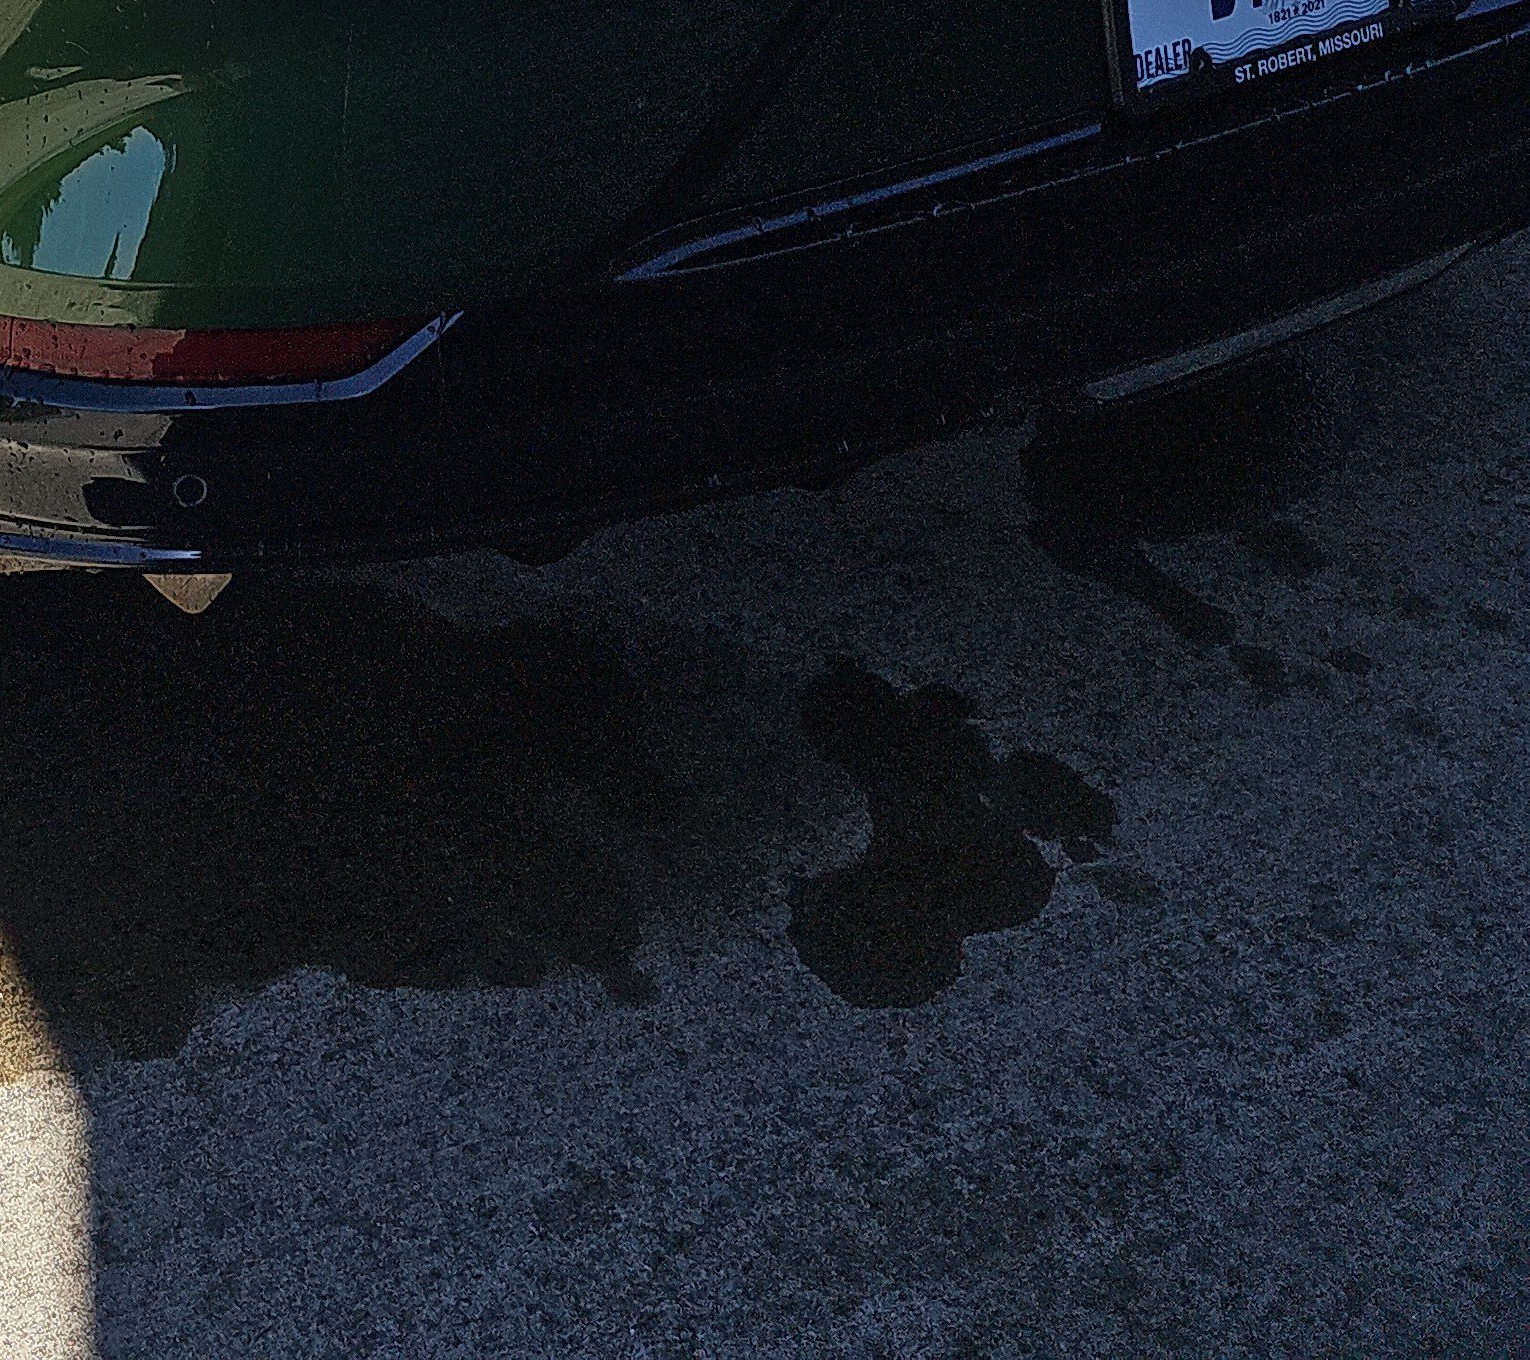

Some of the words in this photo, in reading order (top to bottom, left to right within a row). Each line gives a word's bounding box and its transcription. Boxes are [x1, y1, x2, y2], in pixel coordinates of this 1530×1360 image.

[1268, 6, 1292, 25] 1821
[1134, 38, 1192, 81] DEALER
[1234, 63, 1256, 84] ST.
[1258, 44, 1317, 78] ROBERT,
[1318, 22, 1384, 57] MISSOURI
